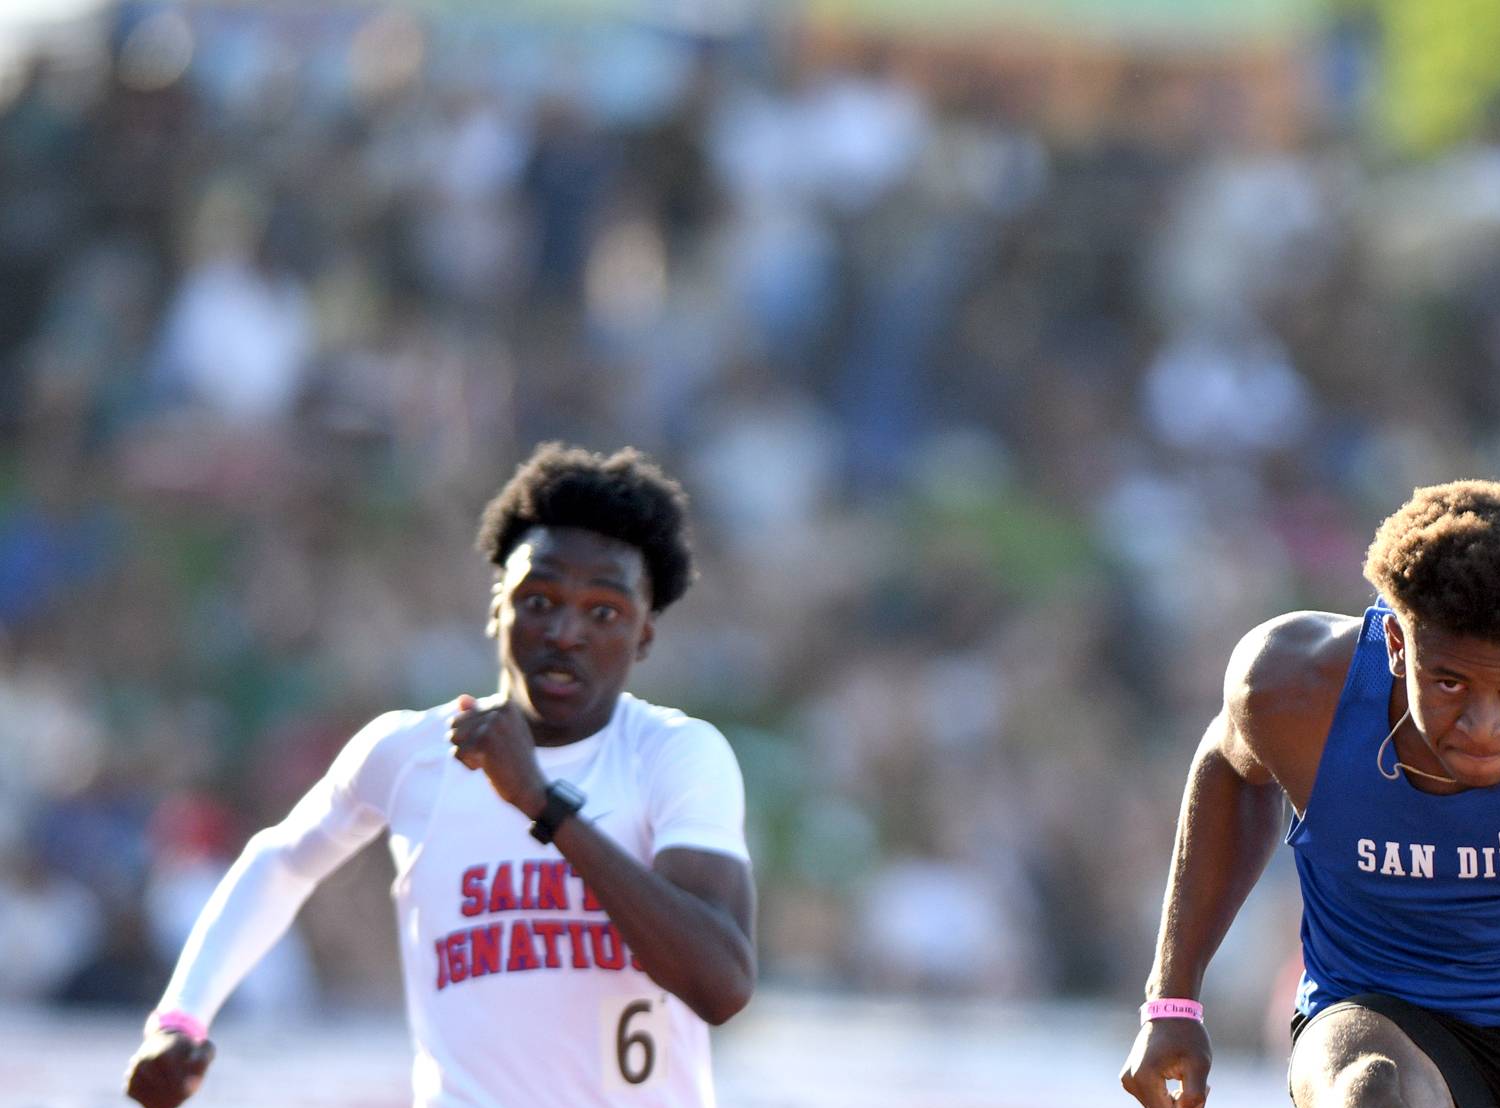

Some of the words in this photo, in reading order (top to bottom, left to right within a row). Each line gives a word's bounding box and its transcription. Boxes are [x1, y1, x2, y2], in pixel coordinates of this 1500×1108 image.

[1356, 838, 1436, 879] SAN
[434, 918, 648, 991] IGNATIU
[616, 998, 657, 1085] 6
